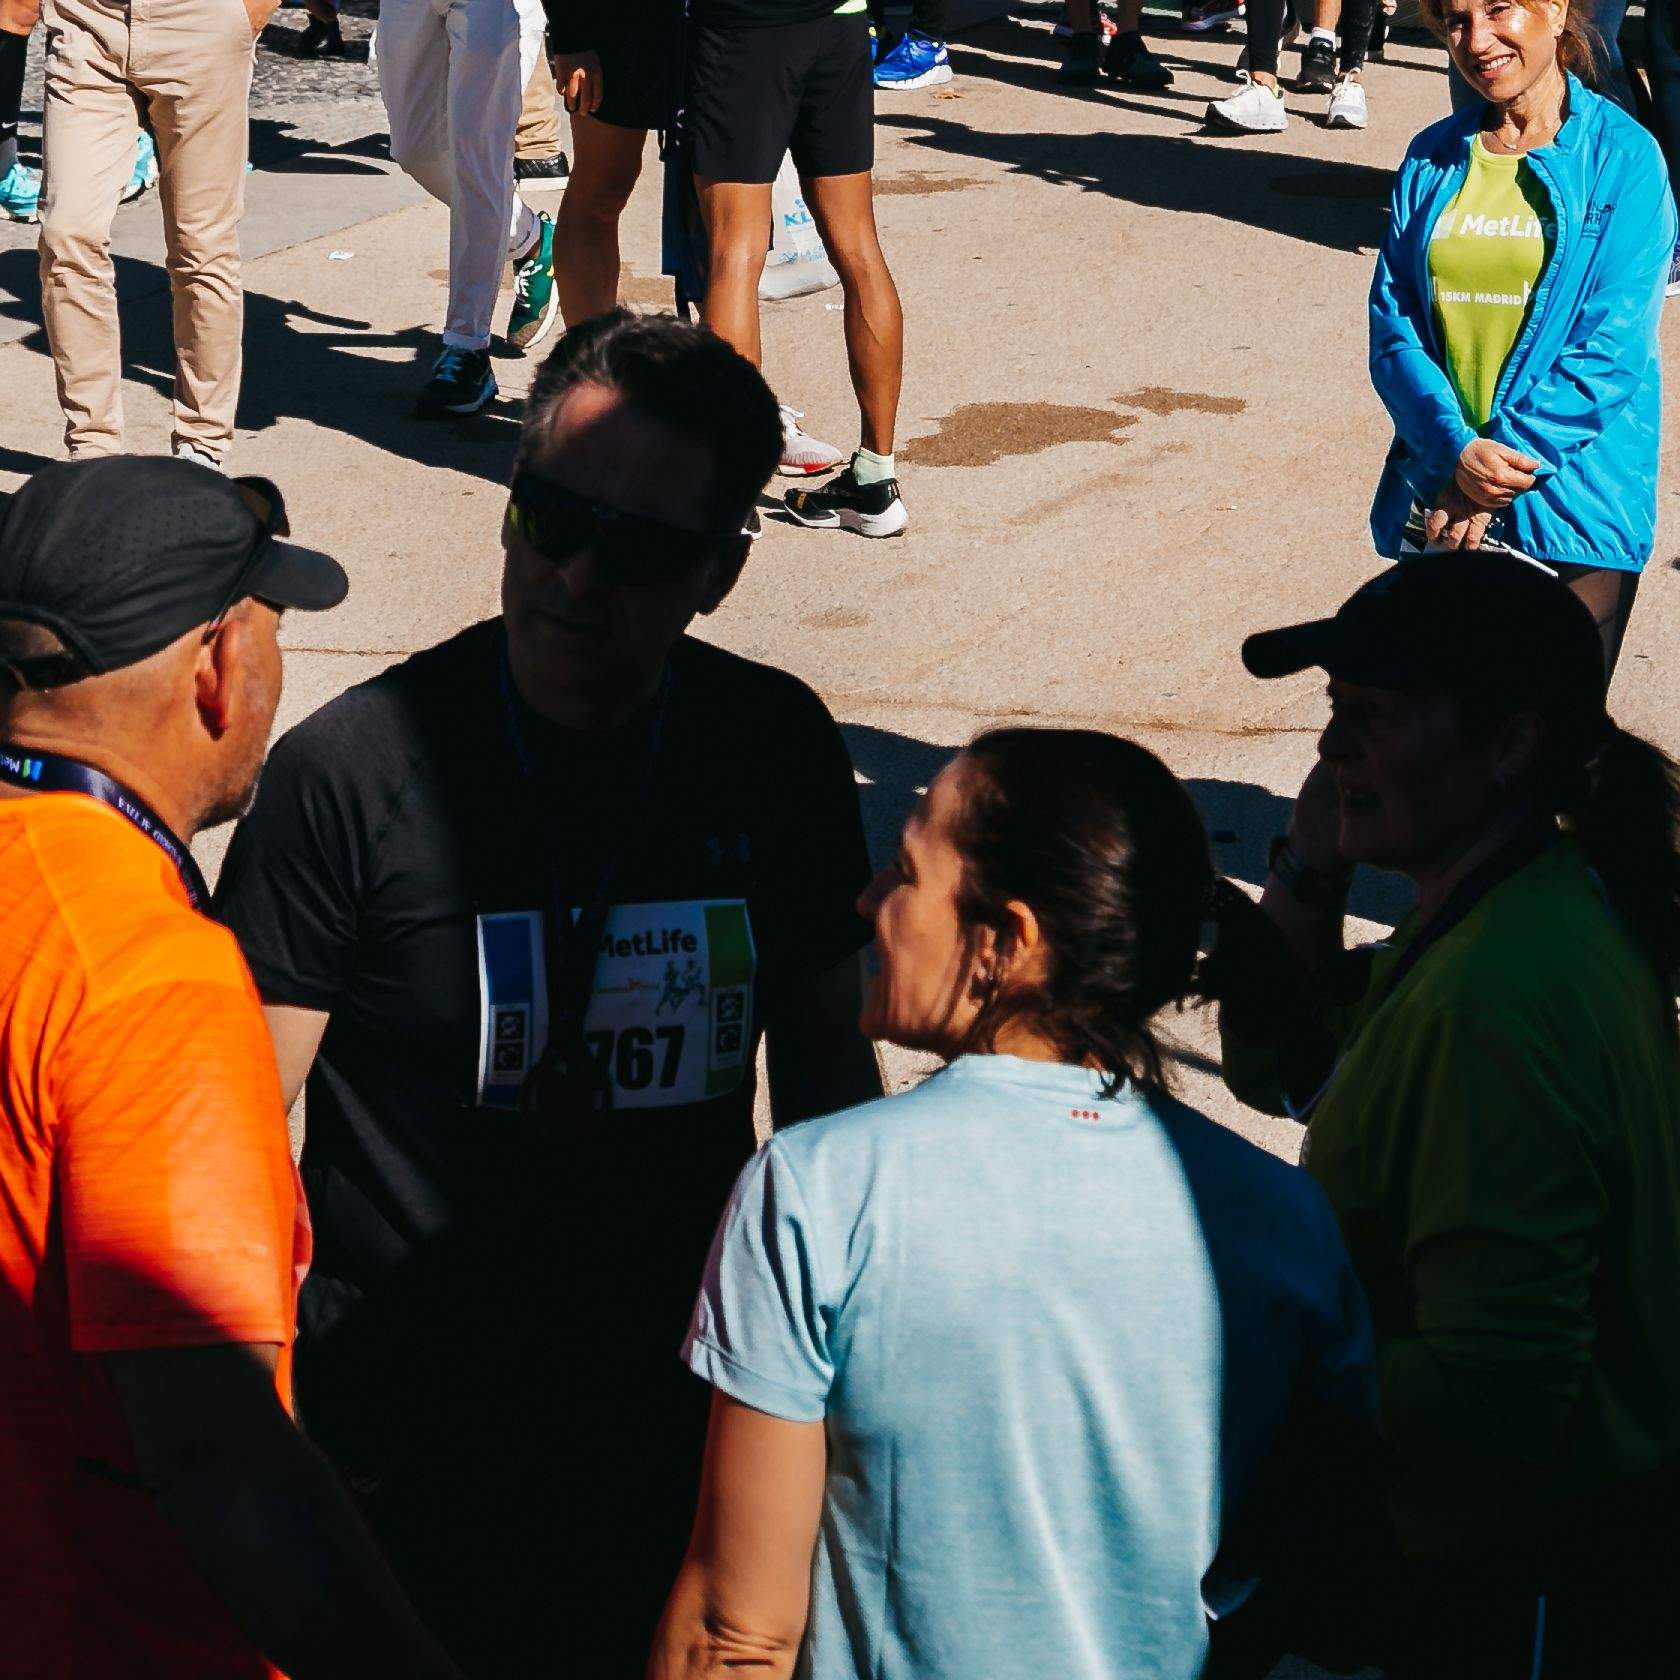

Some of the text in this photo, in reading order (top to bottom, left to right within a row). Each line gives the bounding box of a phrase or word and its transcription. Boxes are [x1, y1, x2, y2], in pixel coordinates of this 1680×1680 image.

[1459, 213, 1558, 240] MetLife
[1439, 290, 1523, 306] 15KM MADRID
